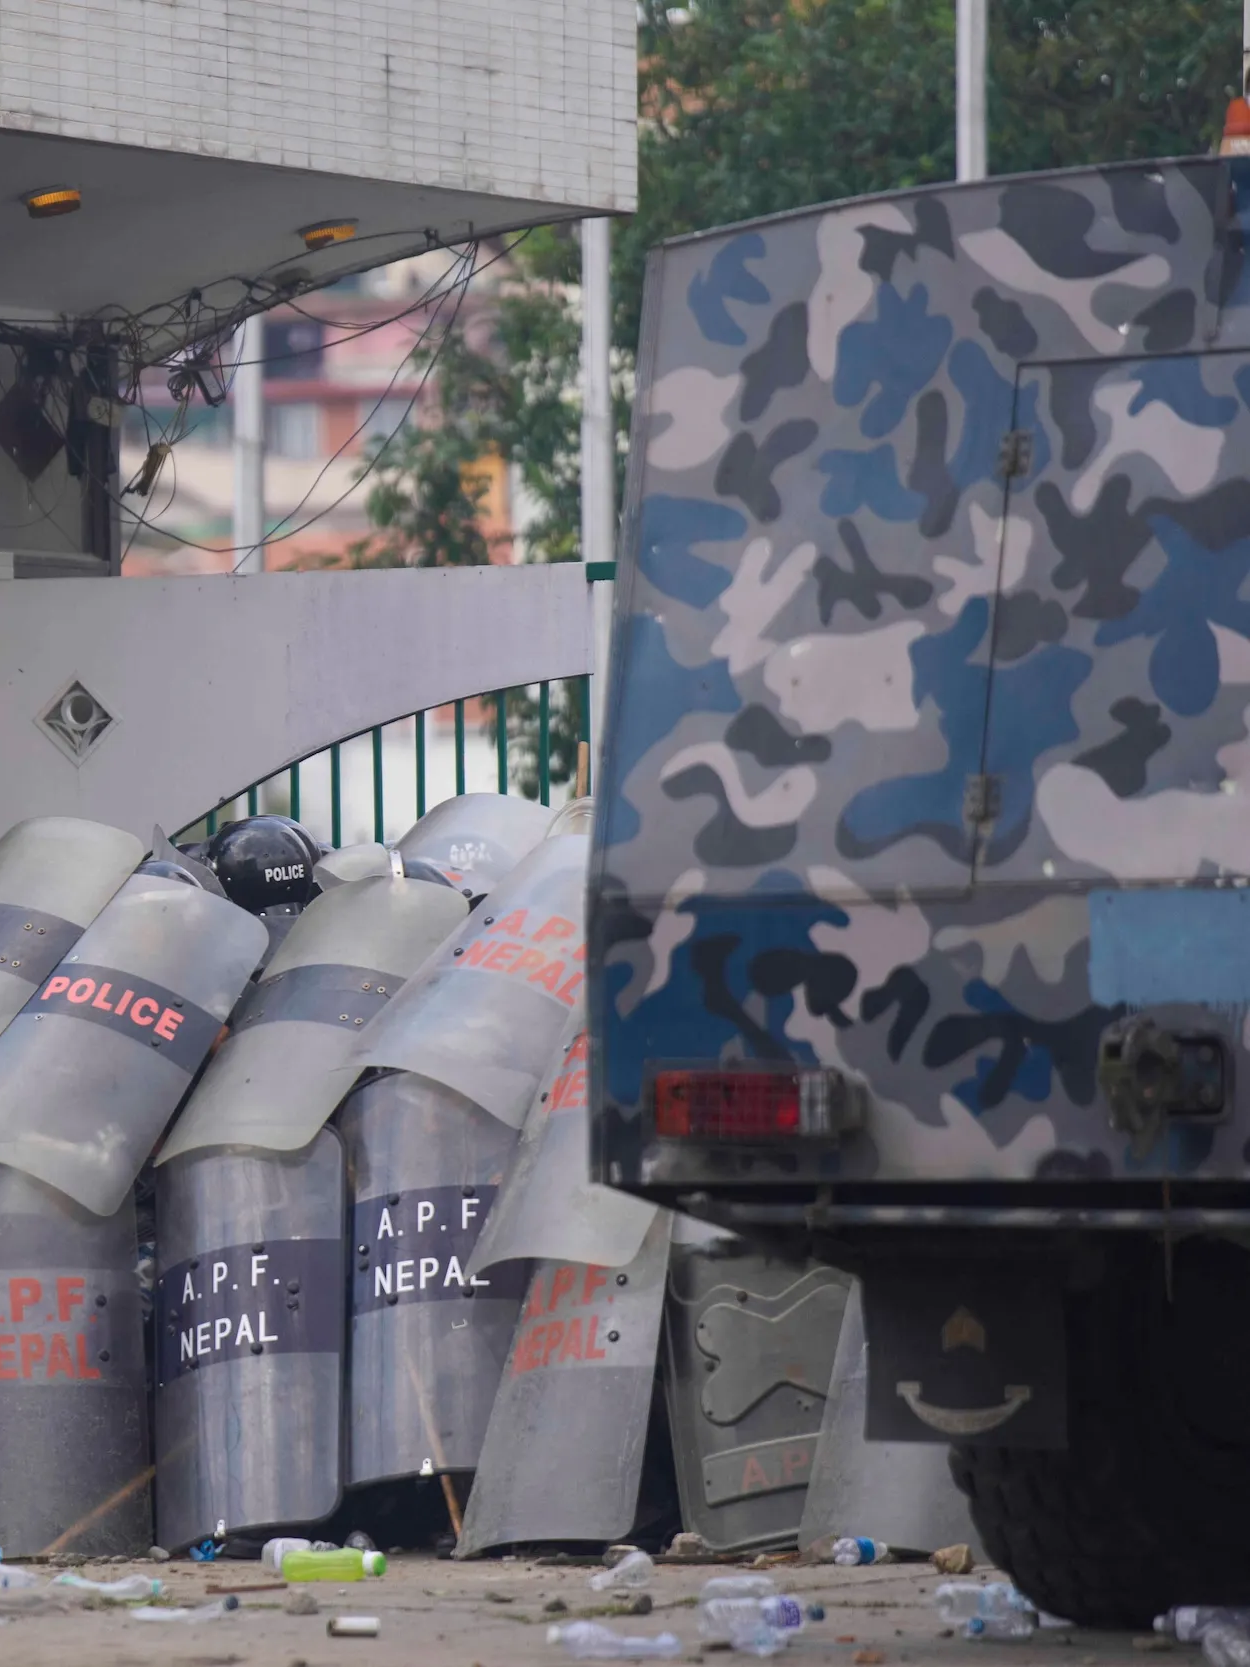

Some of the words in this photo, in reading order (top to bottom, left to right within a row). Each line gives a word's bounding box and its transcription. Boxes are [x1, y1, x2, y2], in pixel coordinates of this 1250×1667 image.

[264, 863, 305, 883] POLICE
[454, 940, 585, 1006] NEPAL
[40, 976, 186, 1041] POLICE
[182, 1254, 281, 1304] A.P.F.
[180, 1311, 279, 1362] NEPAL
